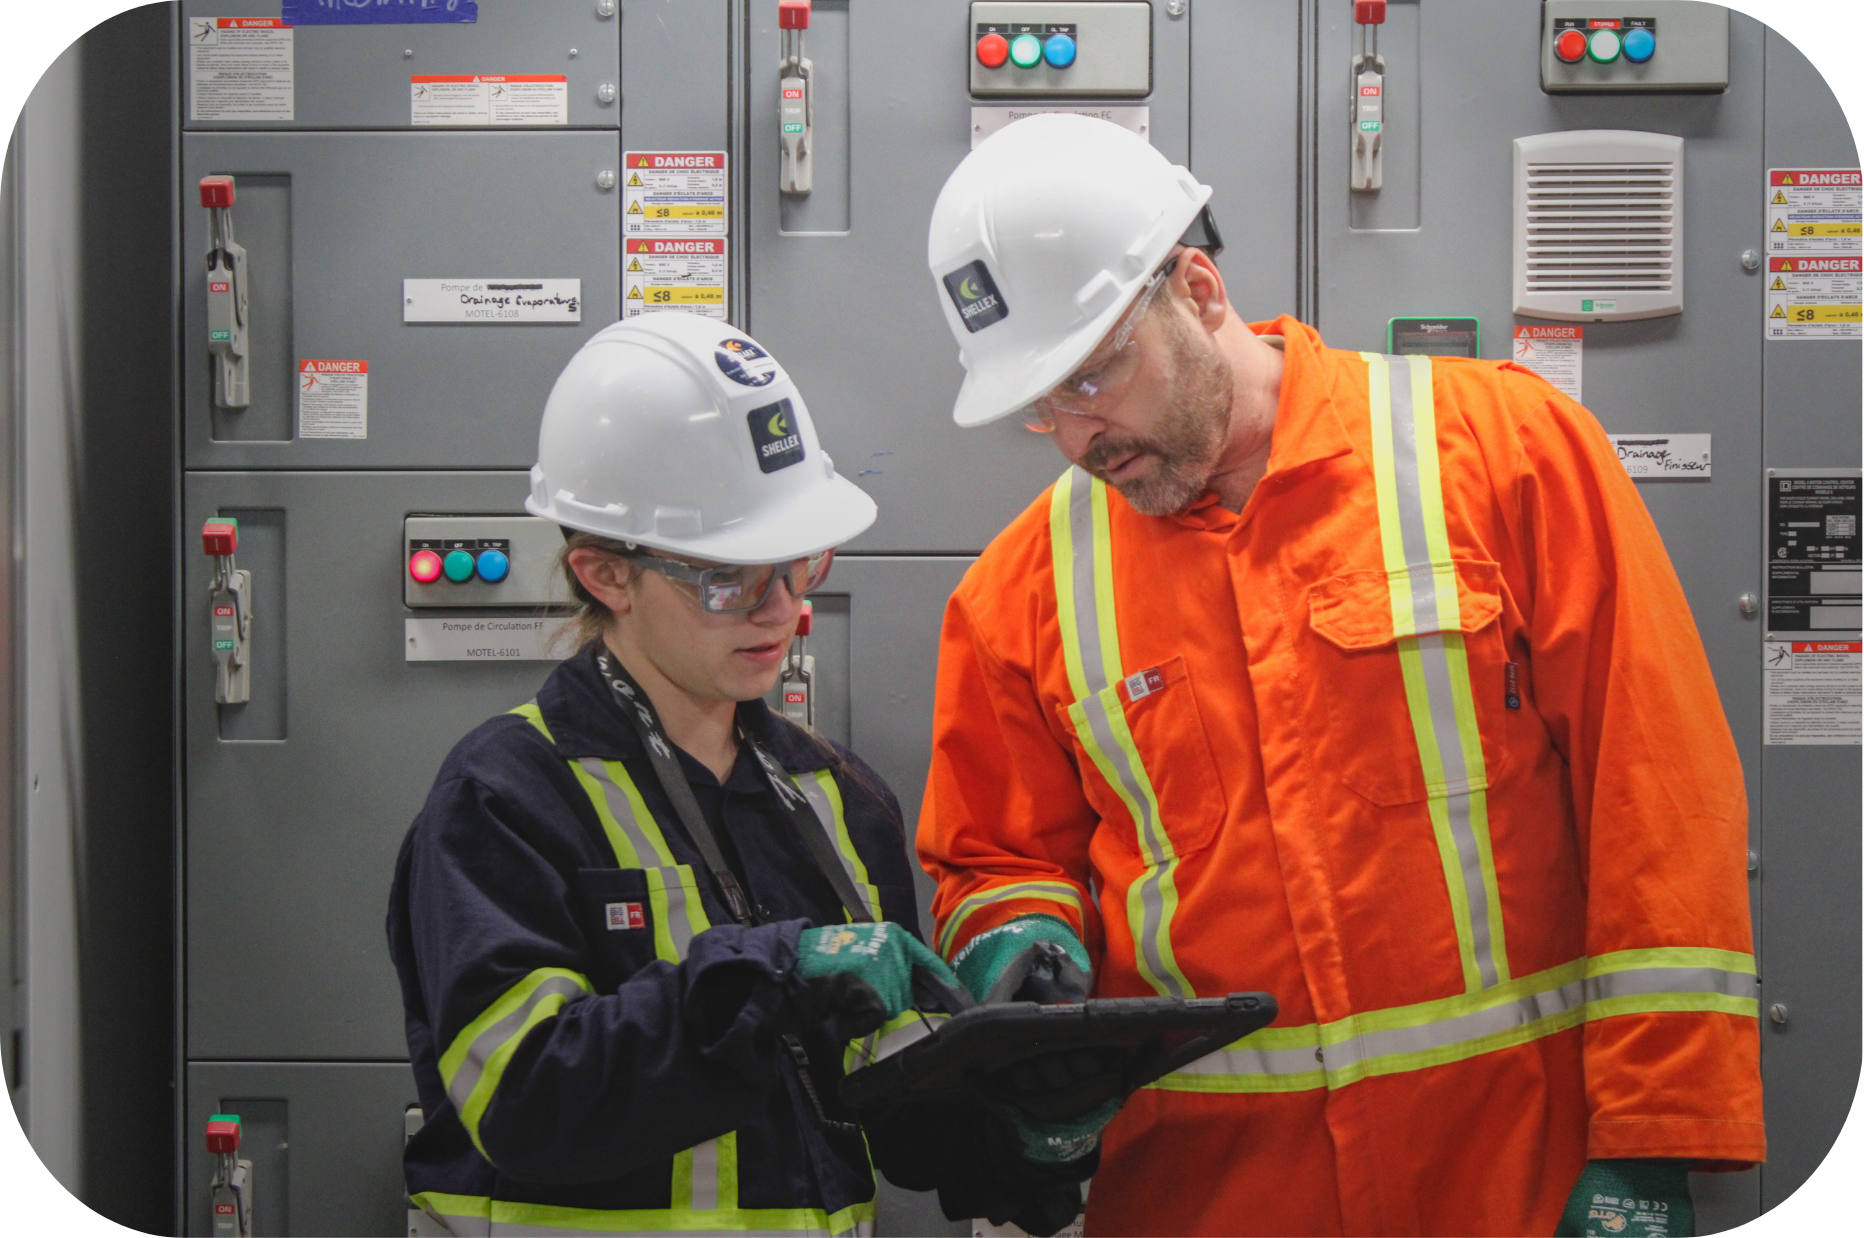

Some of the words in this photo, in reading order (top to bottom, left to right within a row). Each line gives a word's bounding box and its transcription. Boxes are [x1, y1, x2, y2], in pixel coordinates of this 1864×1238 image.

[785, 90, 799, 98] ON
[785, 124, 801, 132] OFF
[655, 157, 714, 167] DANGER
[1799, 174, 1861, 184] DANGER
[655, 242, 714, 252] DANGER
[1798, 260, 1860, 270] DANGER
[441, 284, 471, 292] Pompe
[473, 283, 483, 292] de
[460, 294, 510, 308] Drainage
[962, 294, 999, 319] SHELLEX
[465, 309, 519, 318] MOTEL-6108
[1420, 324, 1448, 332] Schneider
[1533, 328, 1576, 338] DANGER
[212, 331, 229, 339] OFF
[318, 362, 360, 372] DANGER
[761, 433, 800, 457] SHELLEX
[1617, 447, 1671, 465] Drainage
[217, 607, 231, 615] ON
[443, 622, 472, 632] Pompe
[474, 622, 485, 630] de
[487, 622, 532, 631] Circulation
[216, 641, 233, 649] OFF
[466, 649, 520, 657] MOTEL-6101
[1148, 675, 1160, 684] FR
